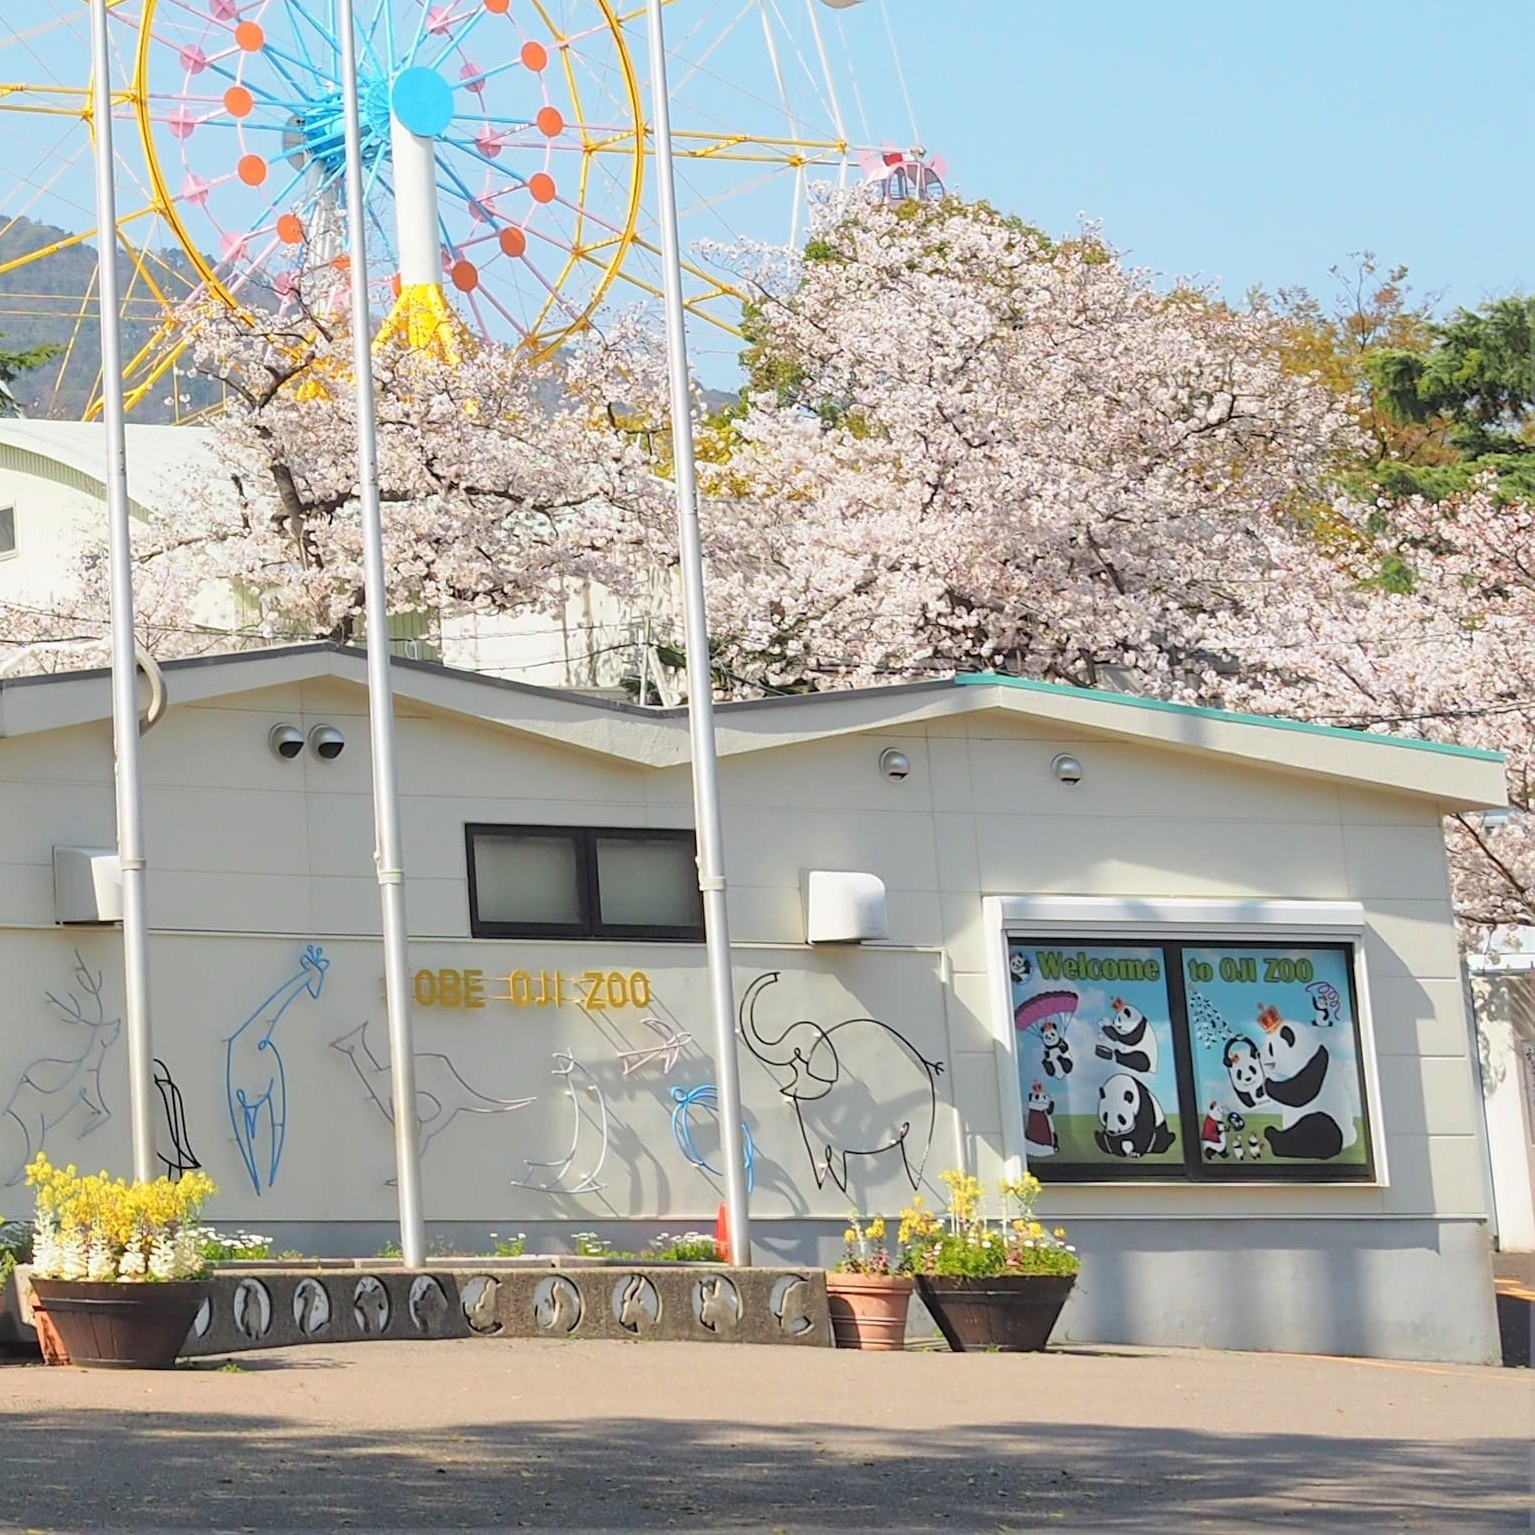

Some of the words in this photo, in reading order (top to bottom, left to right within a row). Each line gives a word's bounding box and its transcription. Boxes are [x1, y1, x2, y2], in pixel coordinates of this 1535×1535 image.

[1035, 950, 1161, 982] Welcome
[1187, 957, 1214, 983] to
[1220, 956, 1258, 983] OJI
[1263, 957, 1315, 984] ZOO
[413, 968, 486, 1009] OBE
[508, 968, 563, 1009] OJI
[584, 971, 651, 1010] ZOO
